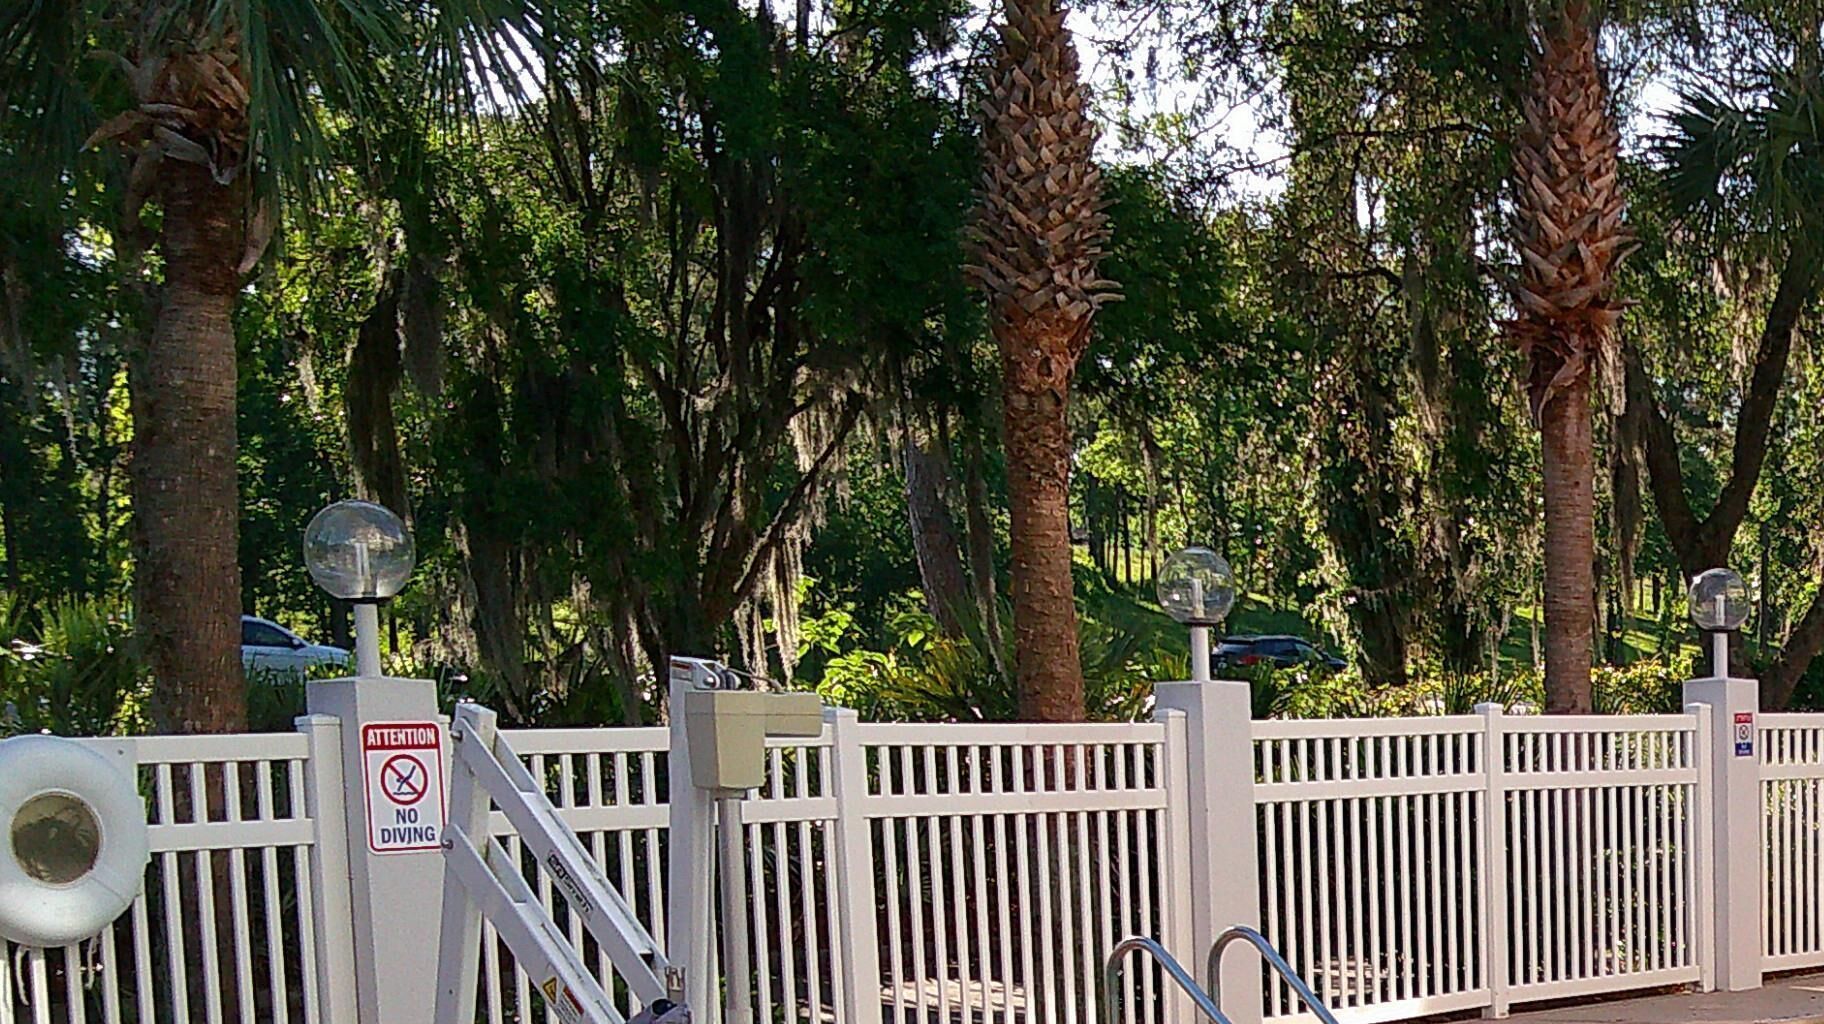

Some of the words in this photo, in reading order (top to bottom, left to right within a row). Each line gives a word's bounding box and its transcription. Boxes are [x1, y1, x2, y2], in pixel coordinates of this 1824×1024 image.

[367, 728, 436, 746] ATTENTION
[396, 808, 418, 825] NO
[381, 826, 436, 844] DIVING
